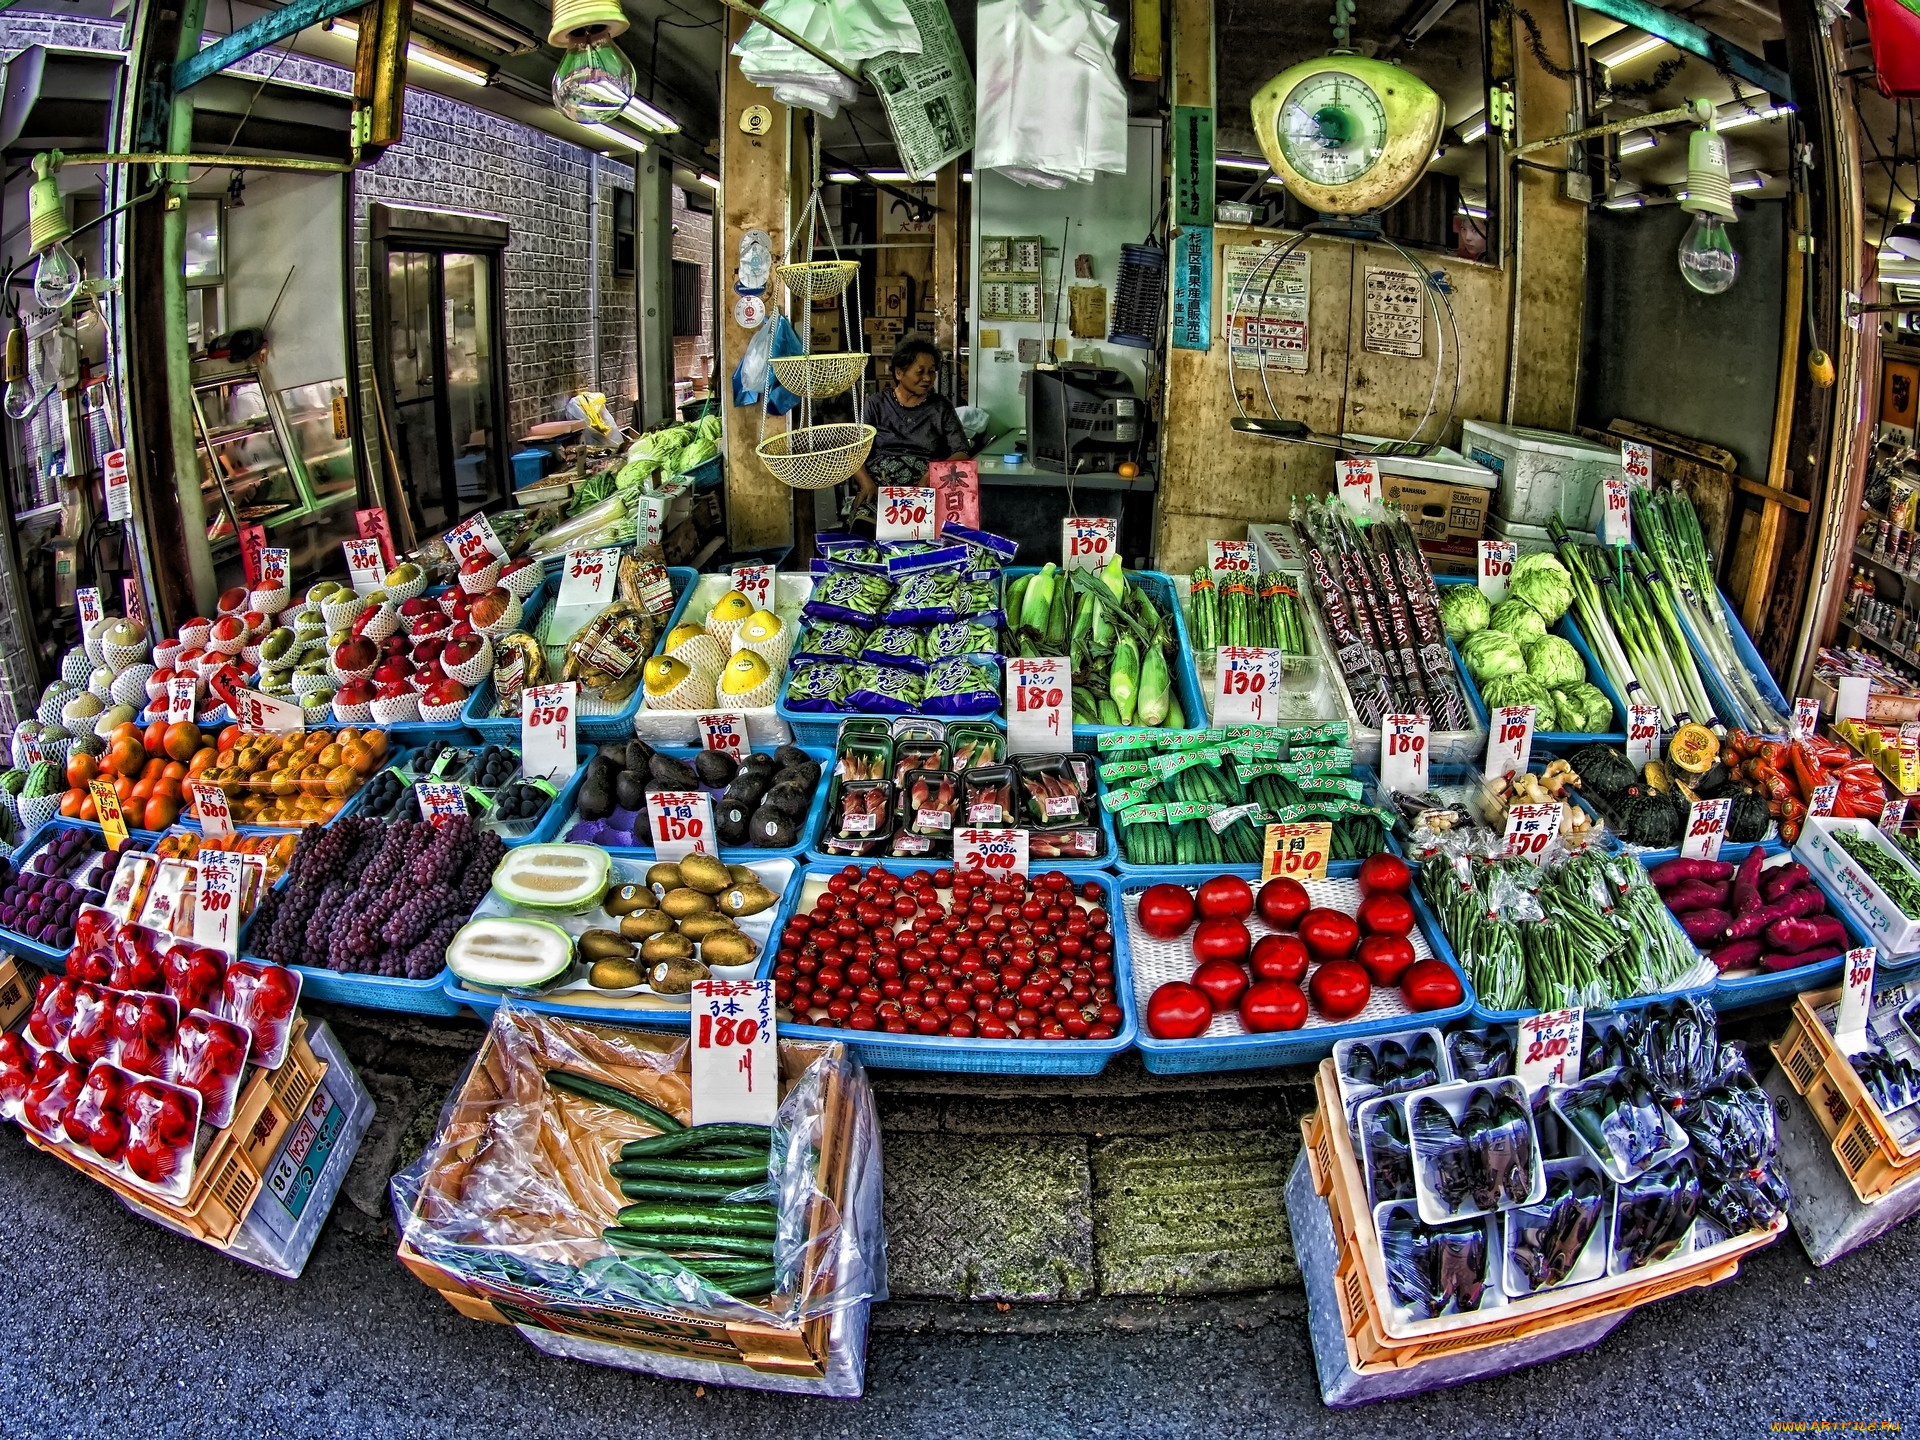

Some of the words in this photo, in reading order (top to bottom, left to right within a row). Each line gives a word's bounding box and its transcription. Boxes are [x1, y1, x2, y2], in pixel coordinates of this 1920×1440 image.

[1175, 288, 1185, 327] 杉並区
[1342, 459, 1376, 468] 特売
[1627, 462, 1648, 476] 250
[1343, 473, 1373, 488] 200
[882, 487, 926, 500] 特売
[938, 465, 969, 524] 本日の
[1402, 487, 1427, 496] BANANAS
[1452, 494, 1482, 504] SUMIFRU
[1609, 494, 1626, 510] 130
[885, 505, 926, 525] 350
[1066, 518, 1109, 528] 特売
[1077, 529, 1101, 538] 1本
[346, 540, 369, 549] 特売
[460, 534, 482, 558] 600
[1071, 537, 1108, 556] 130
[1214, 541, 1247, 551] 特売
[1482, 541, 1512, 550] 特売
[568, 549, 606, 558] 特売
[352, 554, 374, 569] 350
[1214, 557, 1250, 571] 250
[1484, 558, 1513, 577] 150
[264, 568, 284, 580] 600
[570, 564, 604, 578] 300
[732, 566, 773, 577] 特売
[735, 578, 770, 591] 350
[84, 609, 99, 622] 680
[1221, 646, 1270, 660] 特売
[1010, 659, 1063, 675] 特売
[1231, 659, 1263, 672] 1パック
[175, 678, 193, 688] 特売
[1020, 674, 1054, 686] 1パック
[1223, 670, 1266, 694] 130
[526, 683, 570, 700] 特売
[1016, 686, 1063, 712] 180
[172, 698, 192, 712] 500
[534, 696, 562, 708] 1パック
[1798, 698, 1819, 709] 特売
[529, 706, 569, 728] 650
[1500, 706, 1535, 717] 特売
[1630, 705, 1653, 716] 特売
[698, 714, 741, 726] 特売
[1387, 714, 1430, 726] 特売
[1499, 724, 1527, 743] 100
[1630, 724, 1656, 741] 200
[706, 733, 741, 750] 180
[1390, 734, 1425, 756] 180
[28, 750, 42, 764] 800
[96, 788, 116, 798] 特売
[194, 785, 218, 796] 特売
[424, 792, 463, 807] 特売
[650, 792, 706, 807] 特売
[1692, 800, 1724, 812] 特売
[100, 806, 120, 821] 500
[200, 800, 228, 818] 580
[663, 805, 693, 819] 1個
[1510, 806, 1556, 819] 特売
[658, 815, 703, 842] 150
[1270, 822, 1332, 838] 特売
[1688, 818, 1721, 838] 250
[960, 830, 1024, 844] 特売
[1276, 836, 1305, 851] 1個
[1509, 832, 1550, 856] 150
[966, 851, 1016, 870] 300
[1270, 850, 1322, 876] 150
[200, 864, 233, 880] 特売
[206, 880, 226, 892] 1パック
[200, 890, 232, 912] 380
[1836, 870, 1891, 932] さやえんどう
[1848, 949, 1875, 961] 特売
[1849, 966, 1872, 989] 350
[692, 980, 758, 998] 特売
[710, 997, 744, 1018] 3本
[1522, 1010, 1571, 1033] 特売
[698, 1014, 758, 1049] 180
[1536, 1027, 1565, 1043] 1パック
[1524, 1036, 1569, 1064] 200
[291, 1120, 314, 1158] LC-CA
[274, 1160, 292, 1192] 26
